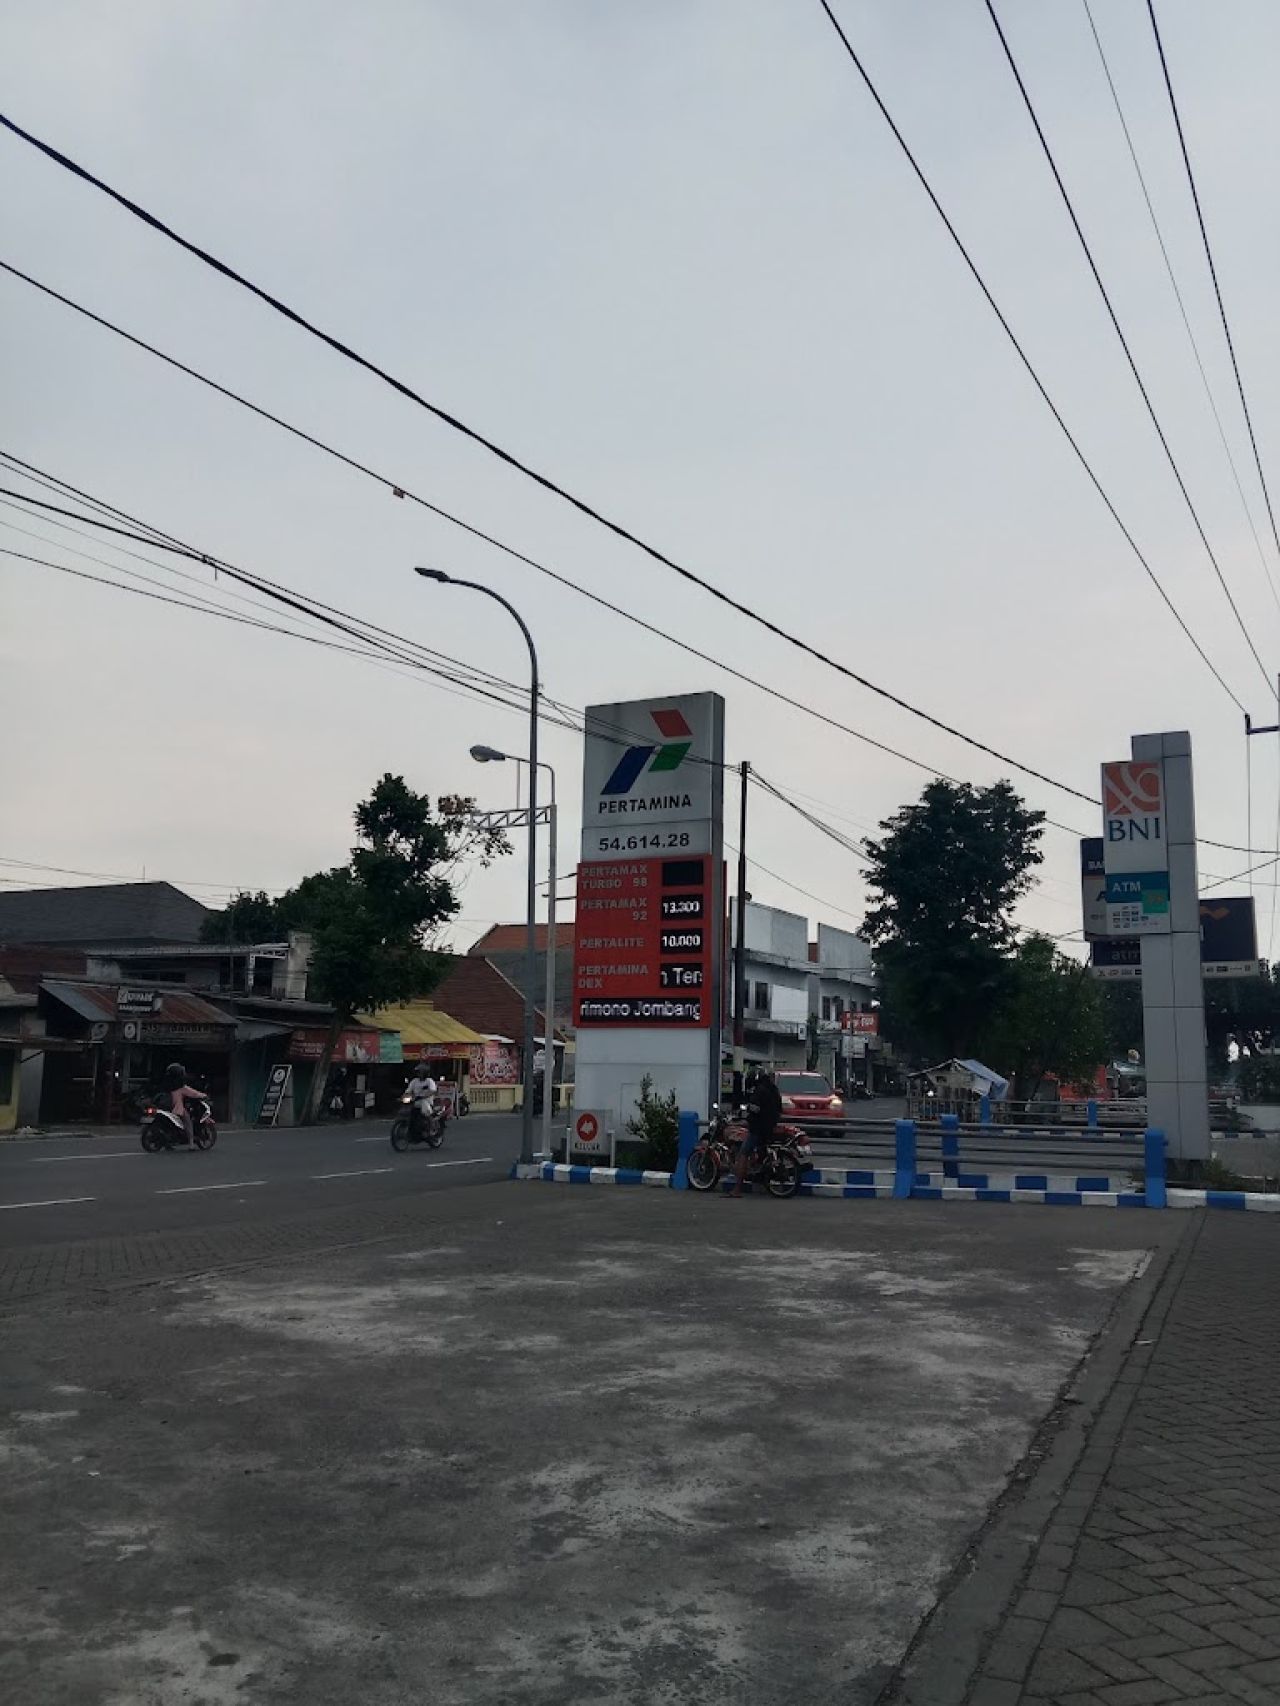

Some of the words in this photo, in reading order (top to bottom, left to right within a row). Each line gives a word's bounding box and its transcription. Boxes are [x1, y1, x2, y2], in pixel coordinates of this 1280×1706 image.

[599, 794, 692, 814] PERTAMINA
[1108, 817, 1160, 841] BNI
[599, 833, 690, 851] 54.614.28
[581, 865, 648, 876] PERTAMAX
[582, 879, 623, 889] TURBO
[632, 877, 648, 887] 98
[1112, 881, 1141, 893] ATM
[581, 898, 648, 909] PERTAMAX
[632, 911, 648, 921] 92
[579, 938, 645, 949] PERTALITE
[662, 935, 701, 947] 10.000
[578, 965, 649, 976] PERTAMINA
[578, 978, 603, 989] DEX
[633, 1000, 701, 1021] Jombang
